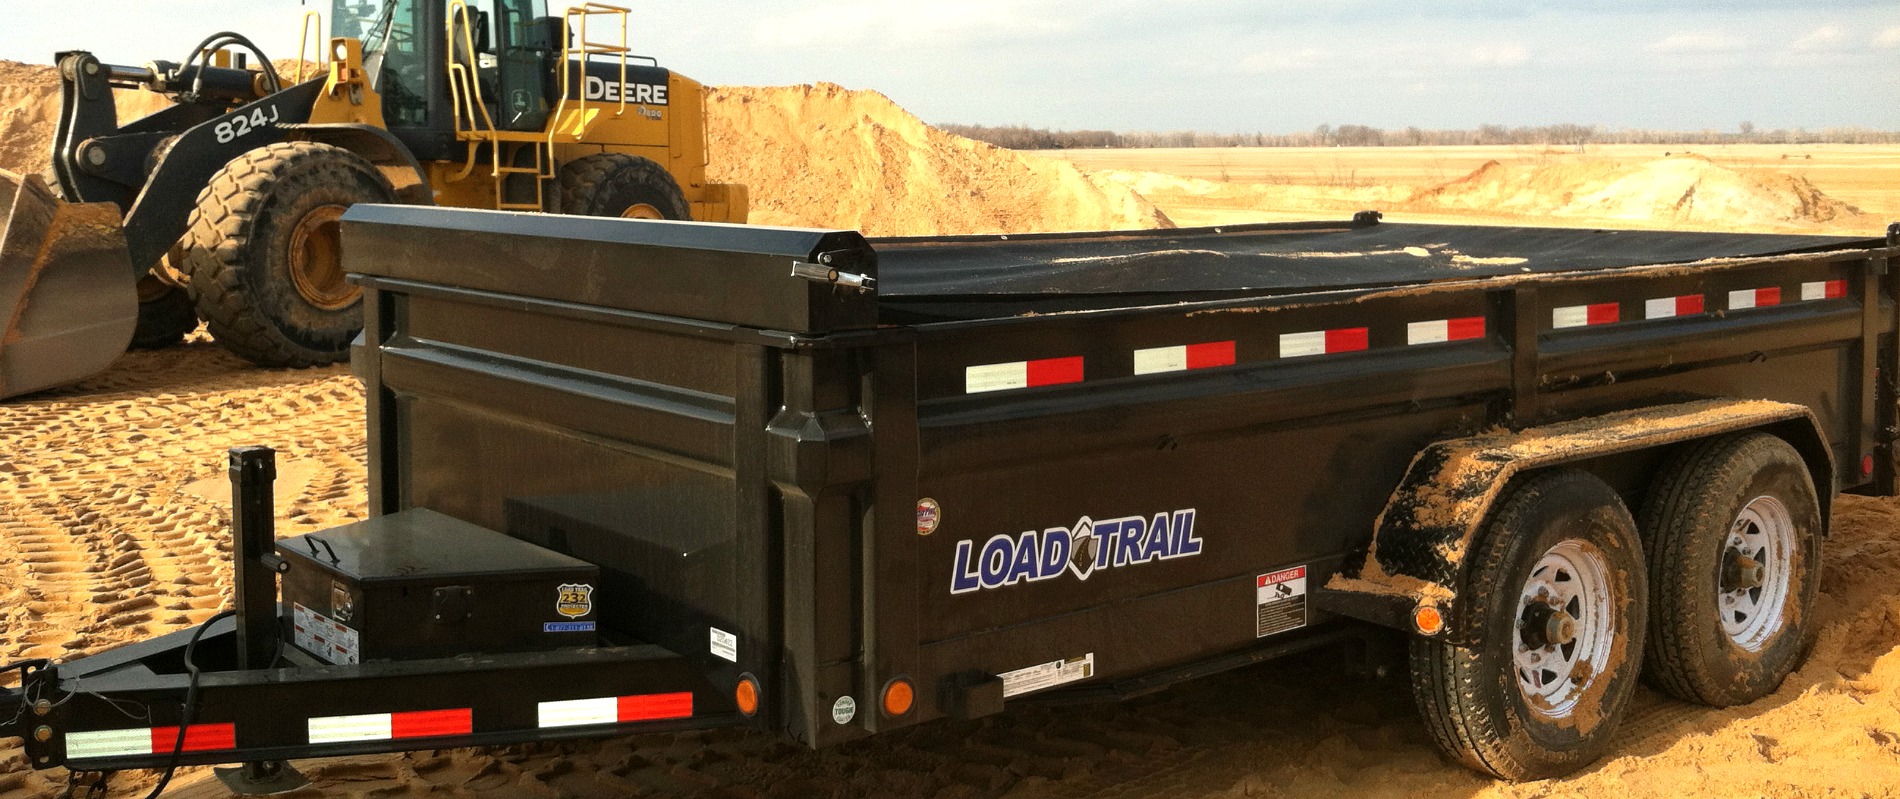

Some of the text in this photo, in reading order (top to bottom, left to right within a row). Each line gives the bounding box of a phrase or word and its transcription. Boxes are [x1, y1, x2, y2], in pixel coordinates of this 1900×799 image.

[585, 75, 667, 104] DEERE
[214, 104, 279, 144] 824J
[951, 508, 1202, 594] LOAD TRAIL
[1271, 570, 1299, 583] DANGER
[563, 593, 586, 603] 232
